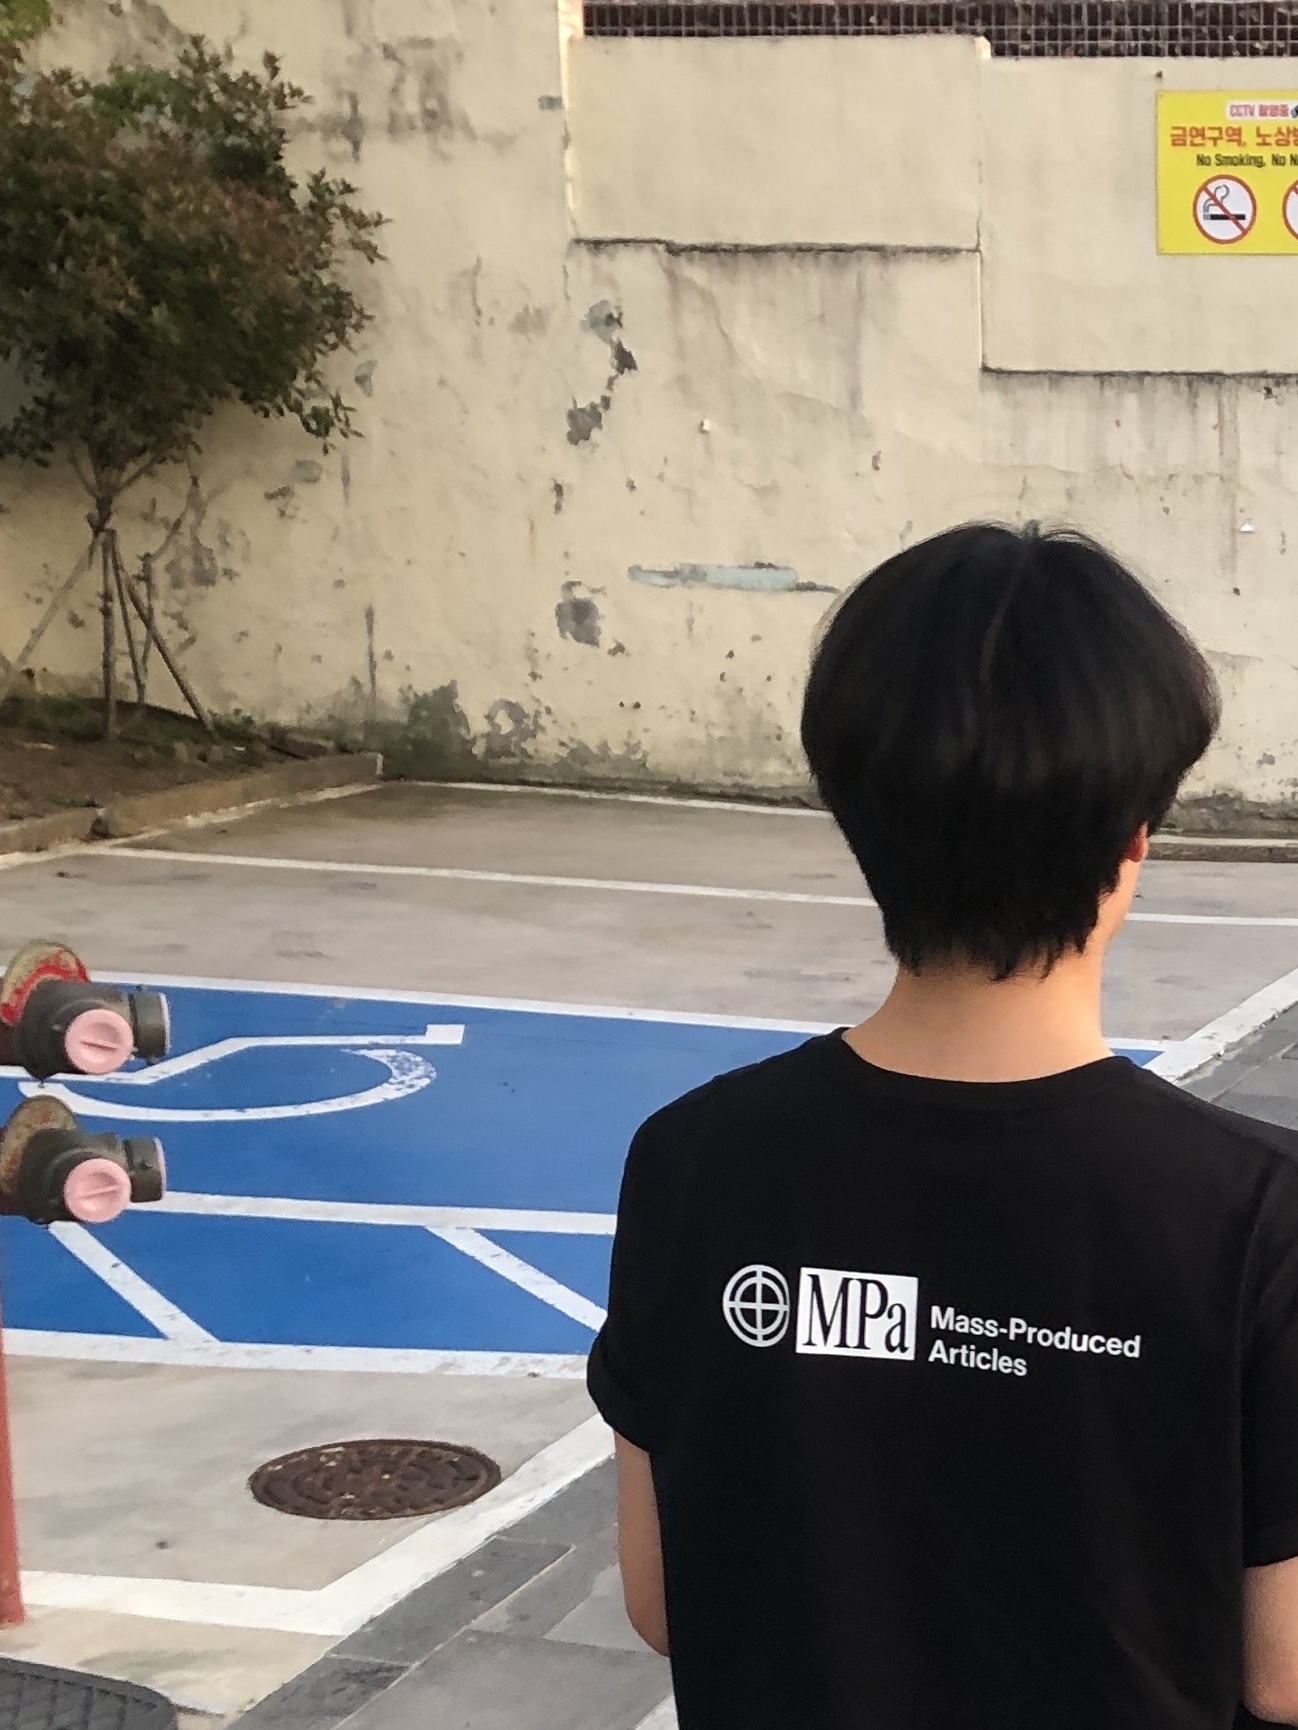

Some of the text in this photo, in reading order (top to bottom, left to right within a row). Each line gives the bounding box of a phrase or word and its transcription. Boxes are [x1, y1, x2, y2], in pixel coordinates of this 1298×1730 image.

[1229, 104, 1255, 117] CCTV
[1170, 126, 1247, 148] 금연구역,
[1196, 154, 1211, 166] No
[1214, 154, 1266, 168] Smoking,
[1271, 154, 1286, 166] No
[802, 1273, 910, 1354] MPa
[929, 1305, 1141, 1358] Mass-Produced
[928, 1340, 1028, 1376] Articles
